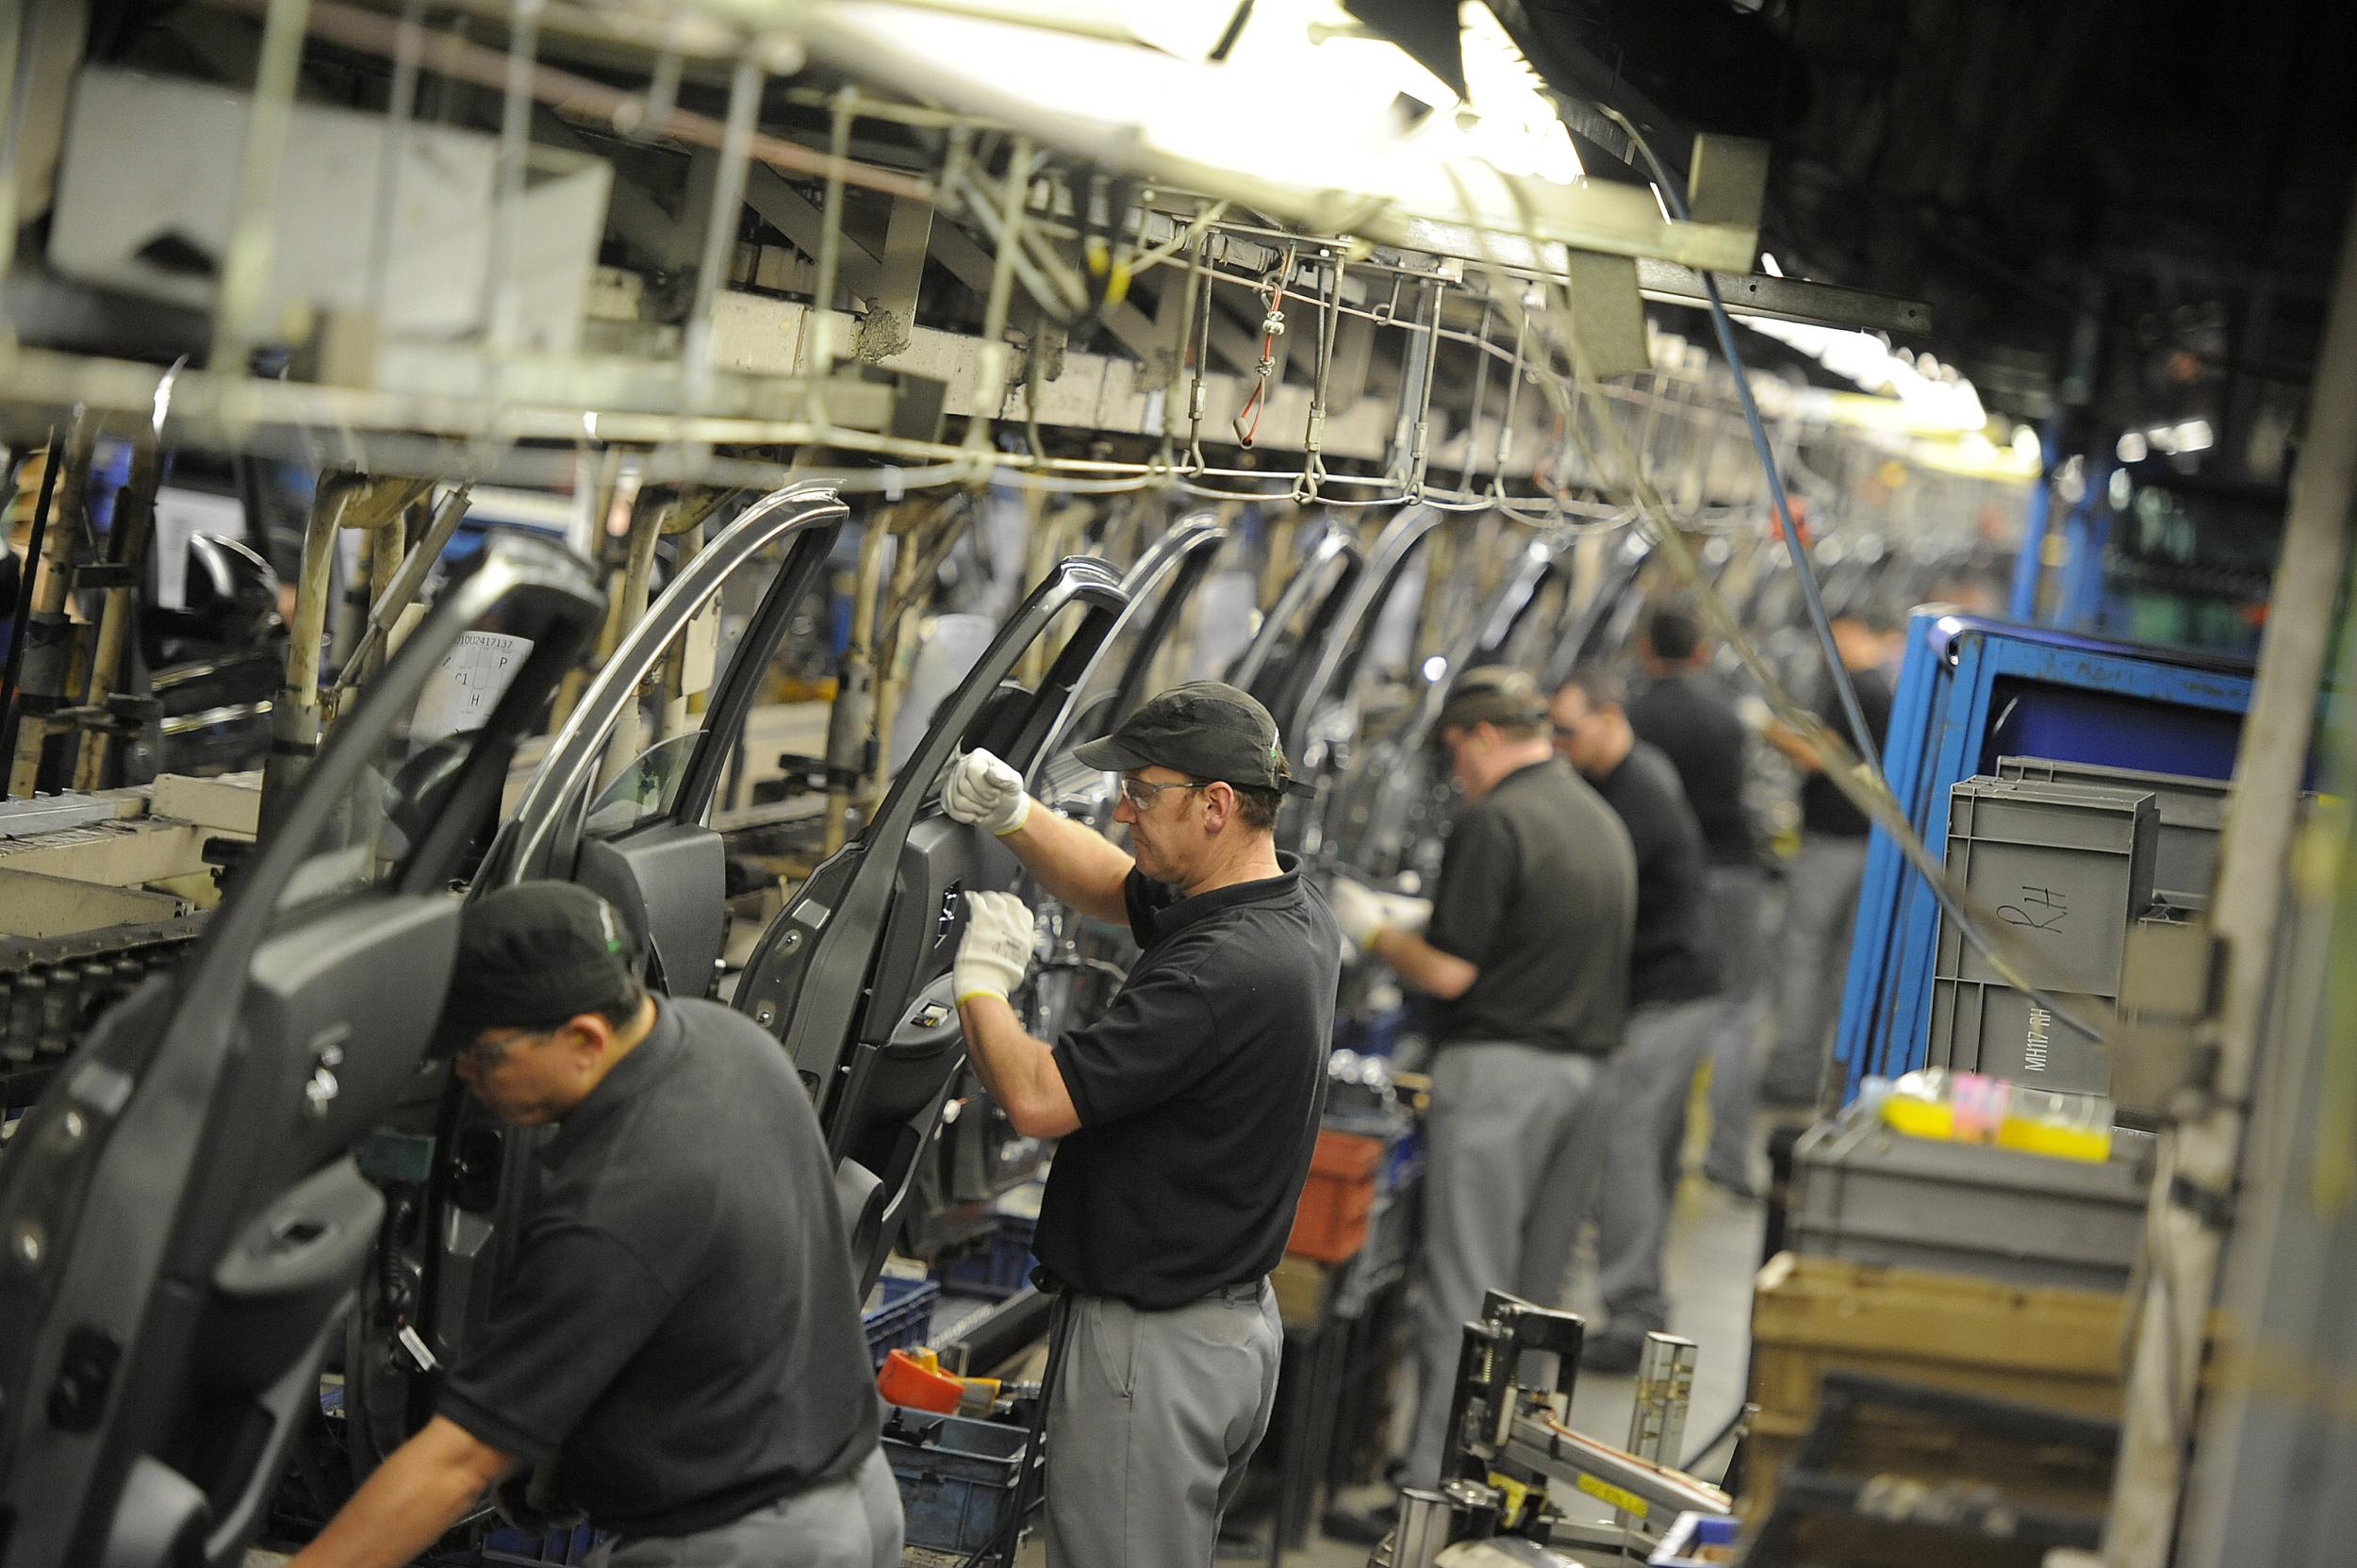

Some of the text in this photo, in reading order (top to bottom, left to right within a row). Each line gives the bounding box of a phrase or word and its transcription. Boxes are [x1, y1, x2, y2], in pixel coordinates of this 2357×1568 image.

[499, 656, 508, 668] P
[470, 693, 480, 706] H
[2024, 1007, 2051, 1071] MH117 RH
